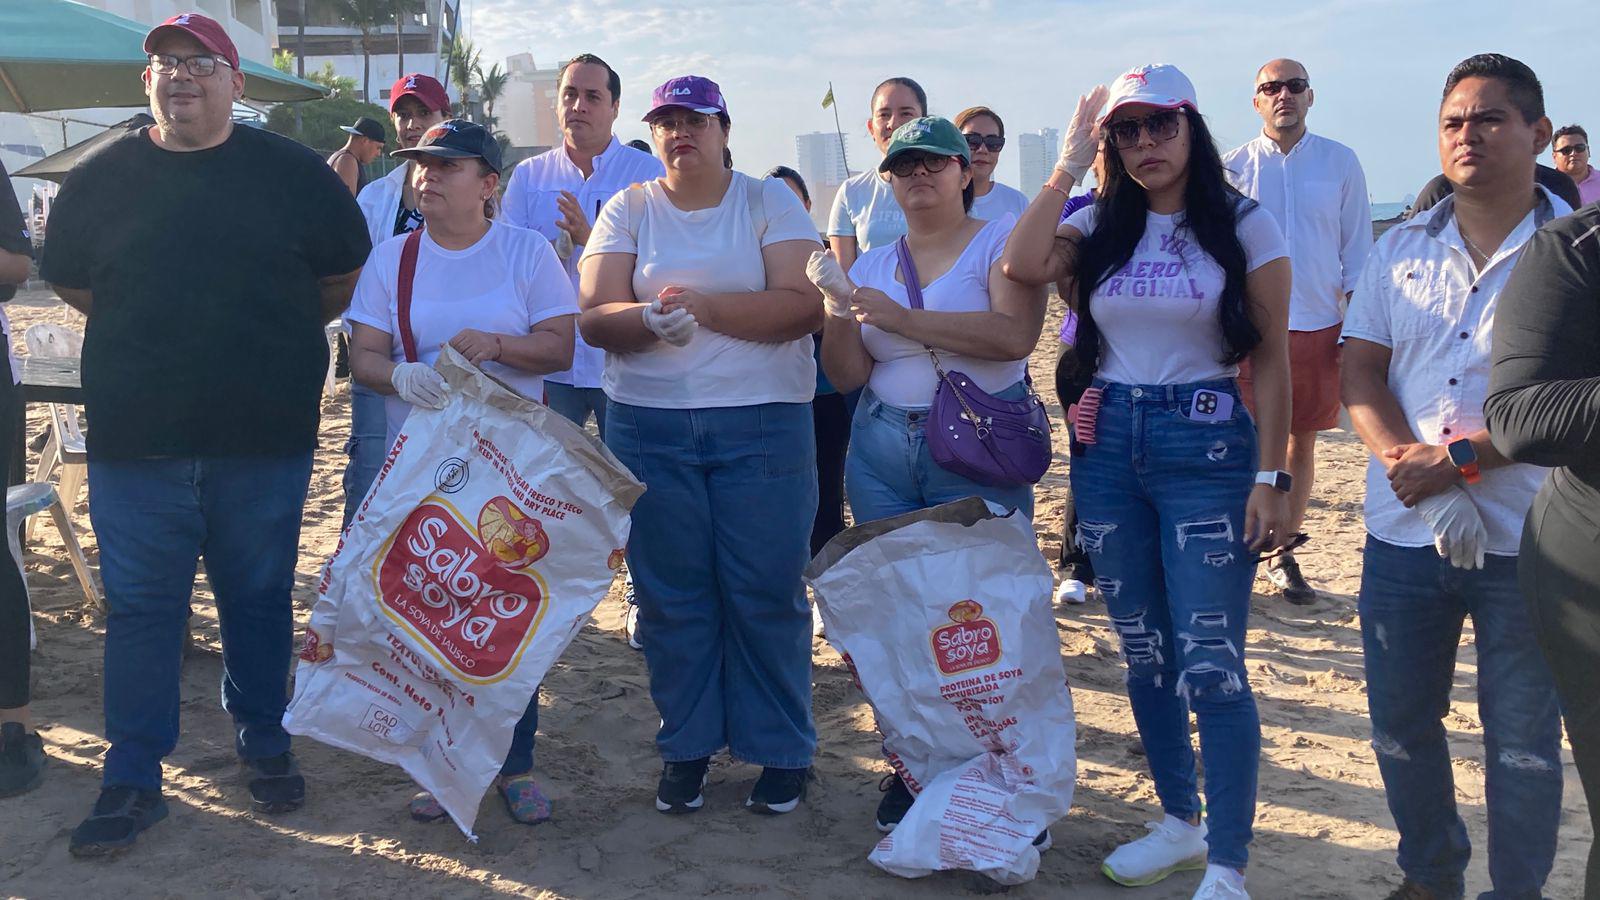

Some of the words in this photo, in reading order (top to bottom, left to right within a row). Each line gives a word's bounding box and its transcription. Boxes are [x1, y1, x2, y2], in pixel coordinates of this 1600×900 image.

[1117, 260, 1183, 279] AERO
[479, 446, 493, 460] KEEP
[492, 460, 499, 469] IN
[512, 487, 525, 501] AND
[524, 498, 541, 512] DRY
[541, 506, 566, 520] PLACE
[529, 488, 555, 506] FRESCO
[557, 500, 563, 508] Y
[563, 502, 583, 514] SECO
[407, 516, 528, 619] Sabro
[403, 562, 498, 650] soya
[394, 593, 407, 611] LA
[407, 604, 432, 631] SOYA
[430, 622, 443, 641] DE
[440, 634, 476, 670] JALISCO
[938, 626, 992, 650] Sabro
[945, 642, 990, 663] soya
[371, 661, 401, 689] Cont.
[403, 683, 433, 712] Neto
[940, 677, 982, 694] PROTEINA
[984, 673, 997, 683] DE
[998, 668, 1023, 680] SOYA
[368, 721, 391, 738] LOTE
[373, 710, 398, 728] CAD
